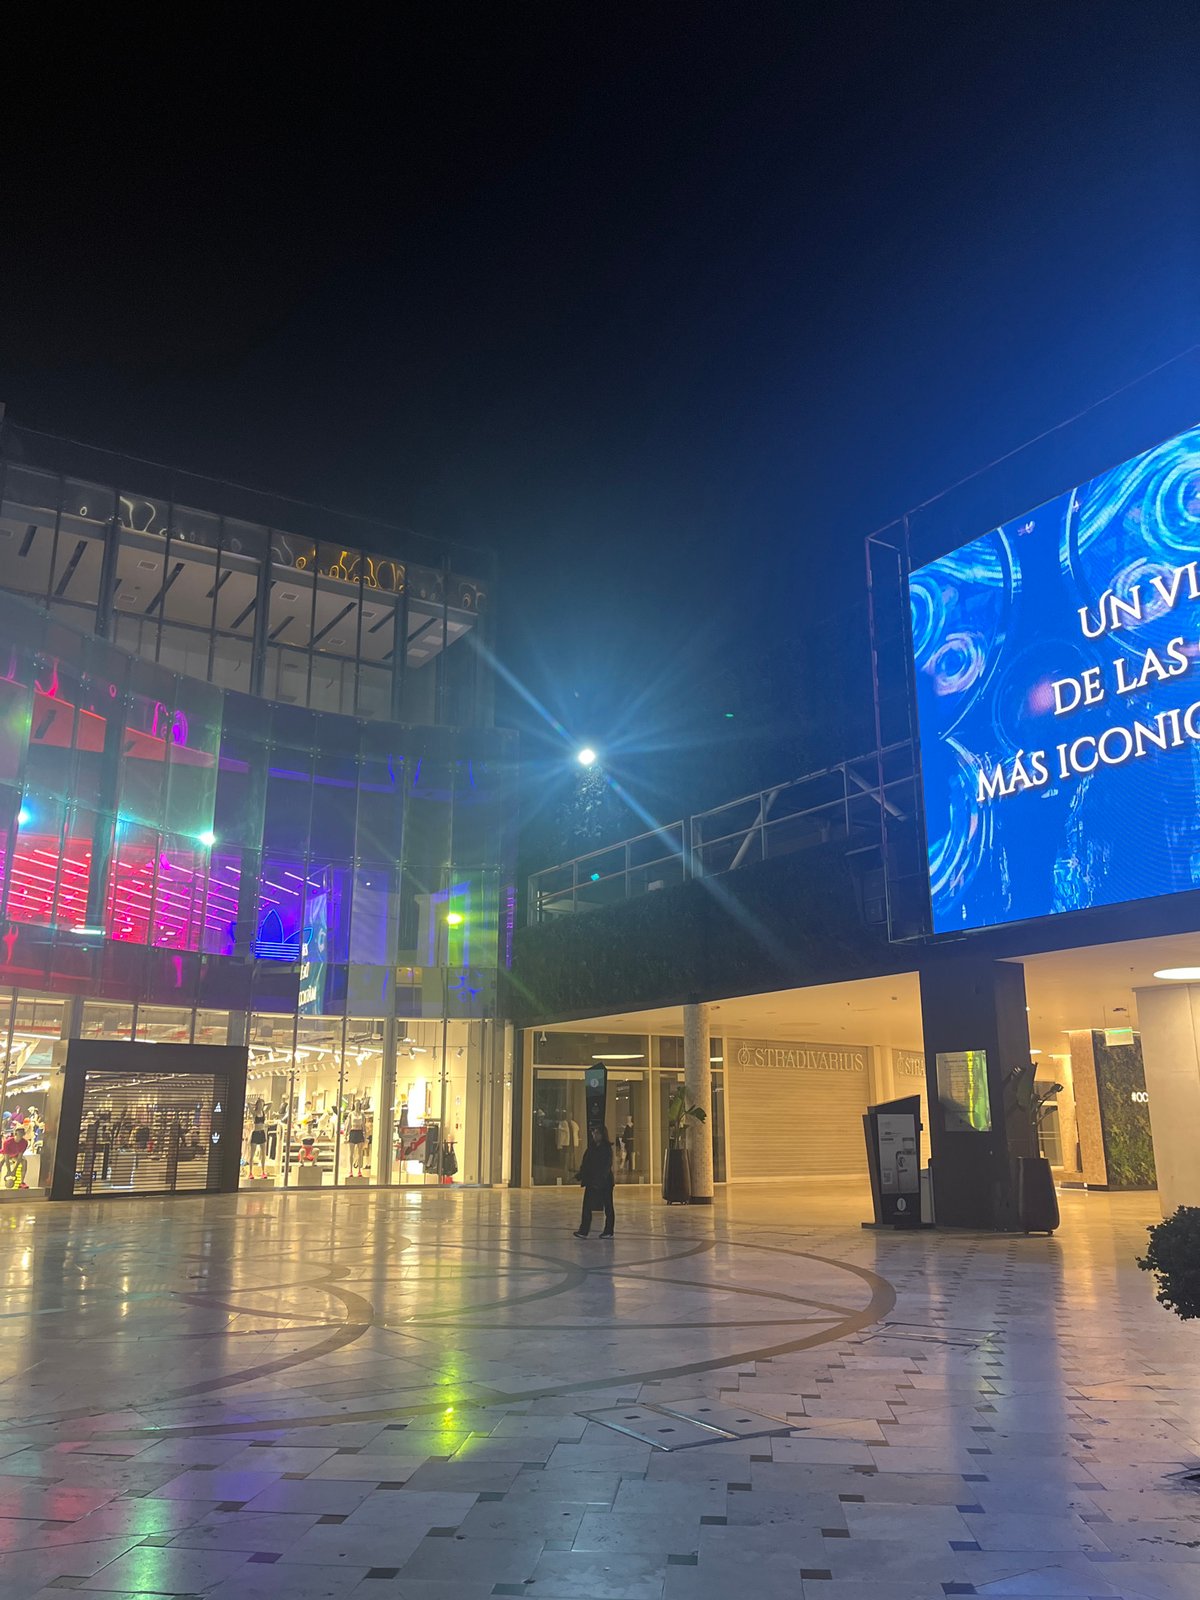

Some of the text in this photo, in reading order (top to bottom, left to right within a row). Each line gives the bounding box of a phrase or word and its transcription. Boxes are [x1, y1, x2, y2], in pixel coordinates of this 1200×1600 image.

[1077, 585, 1142, 638] UN
[1051, 666, 1105, 715] DE
[1113, 637, 1188, 695] LAS
[976, 748, 1049, 802] MÁS
[755, 1047, 864, 1072] STRADIVARIUS
